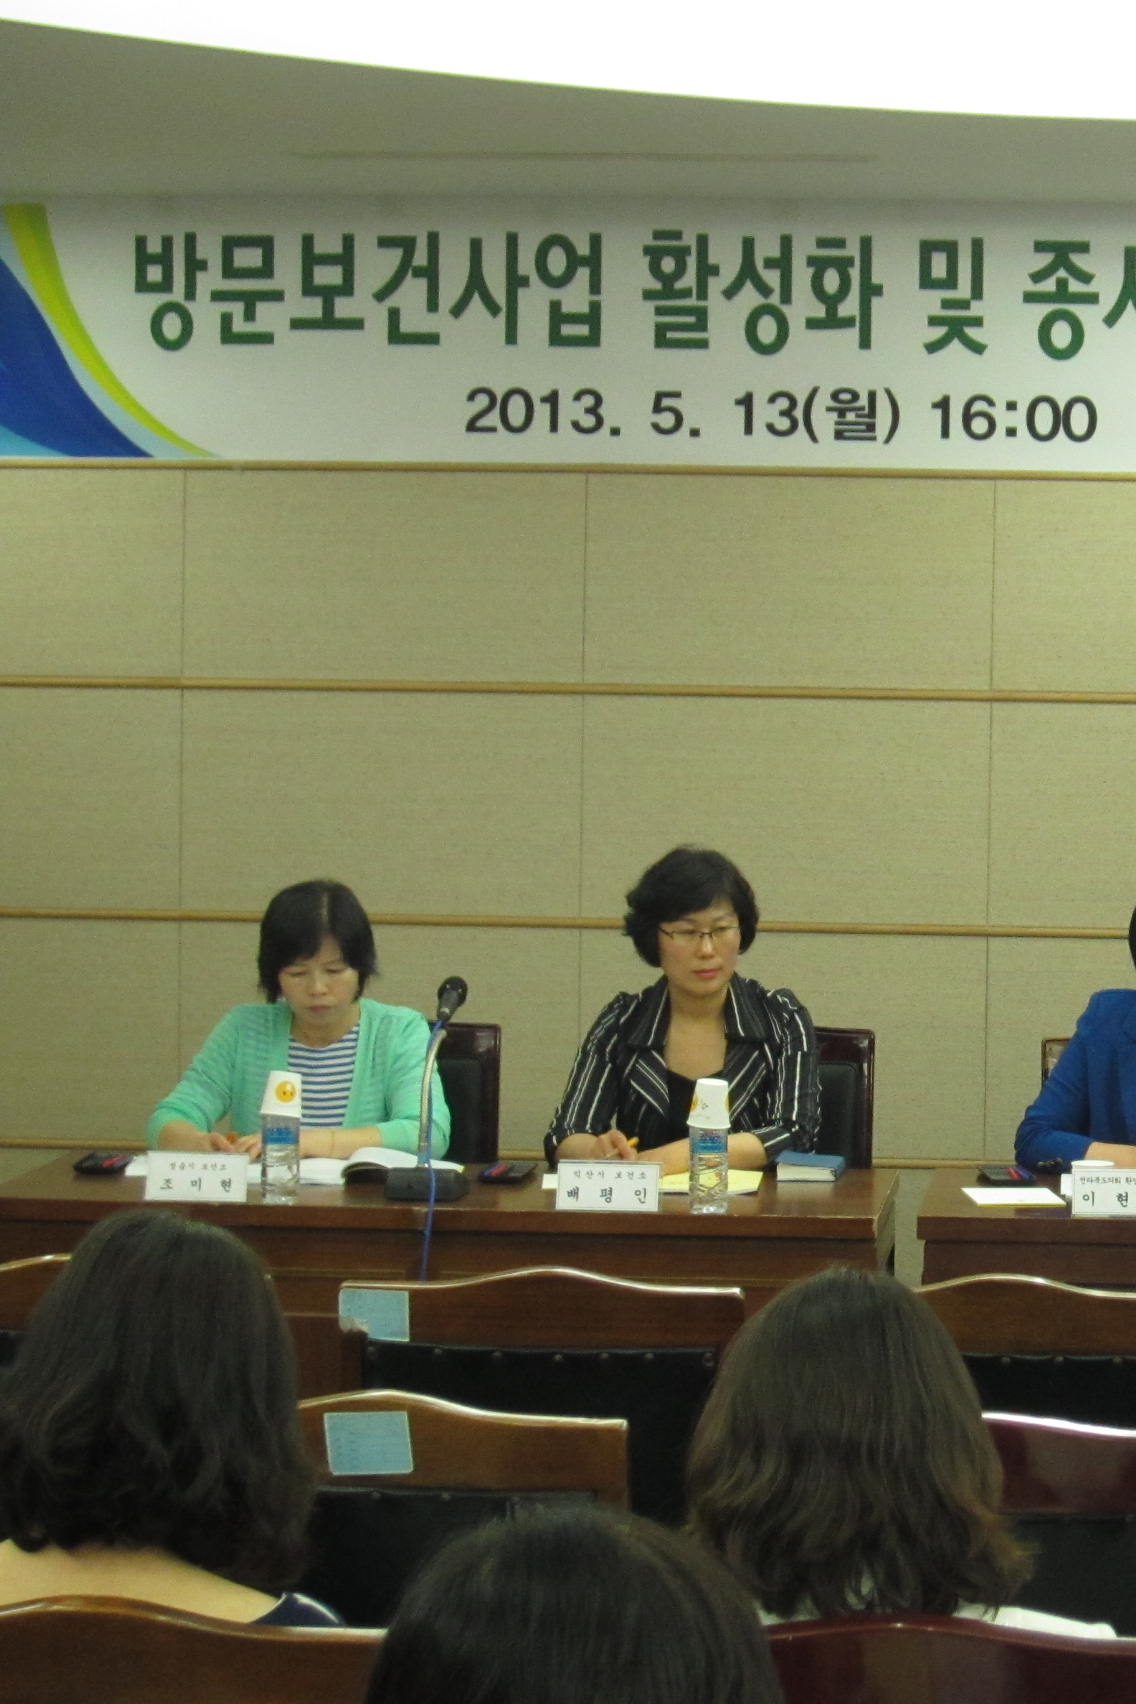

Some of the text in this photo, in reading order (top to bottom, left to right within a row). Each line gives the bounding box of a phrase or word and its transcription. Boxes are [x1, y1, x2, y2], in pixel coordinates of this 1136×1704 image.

[135, 230, 602, 350] 방문보건사업
[642, 228, 883, 355] 활성화
[919, 237, 987, 355] 및
[466, 386, 1097, 443] 2013. 5. 13(월) 16:00
